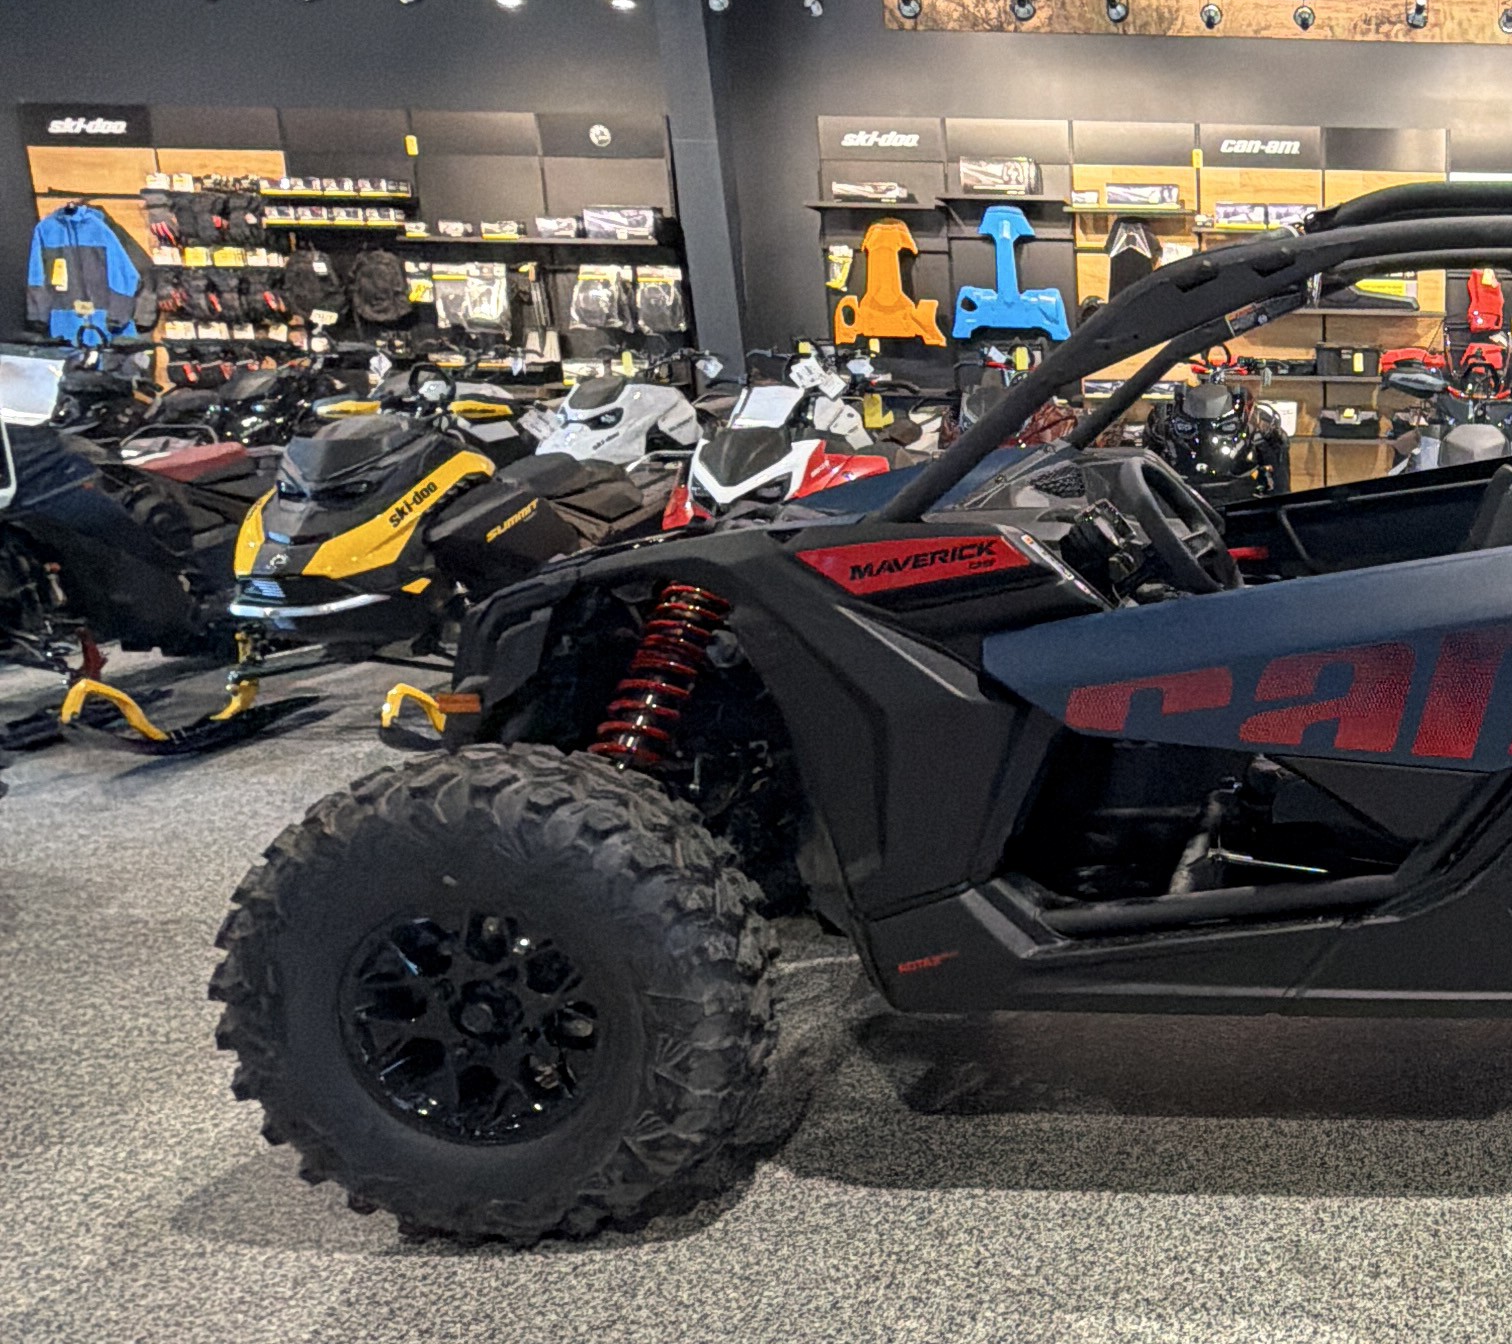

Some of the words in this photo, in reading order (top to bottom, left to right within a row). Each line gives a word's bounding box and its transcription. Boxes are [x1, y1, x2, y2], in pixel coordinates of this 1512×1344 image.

[47, 117, 128, 134] ski-doo
[841, 130, 920, 147] ski-doo
[1220, 139, 1300, 155] can-am
[388, 481, 438, 528] ski-doo
[485, 498, 538, 543] SUMMIT
[849, 539, 998, 581] MAVERICK
